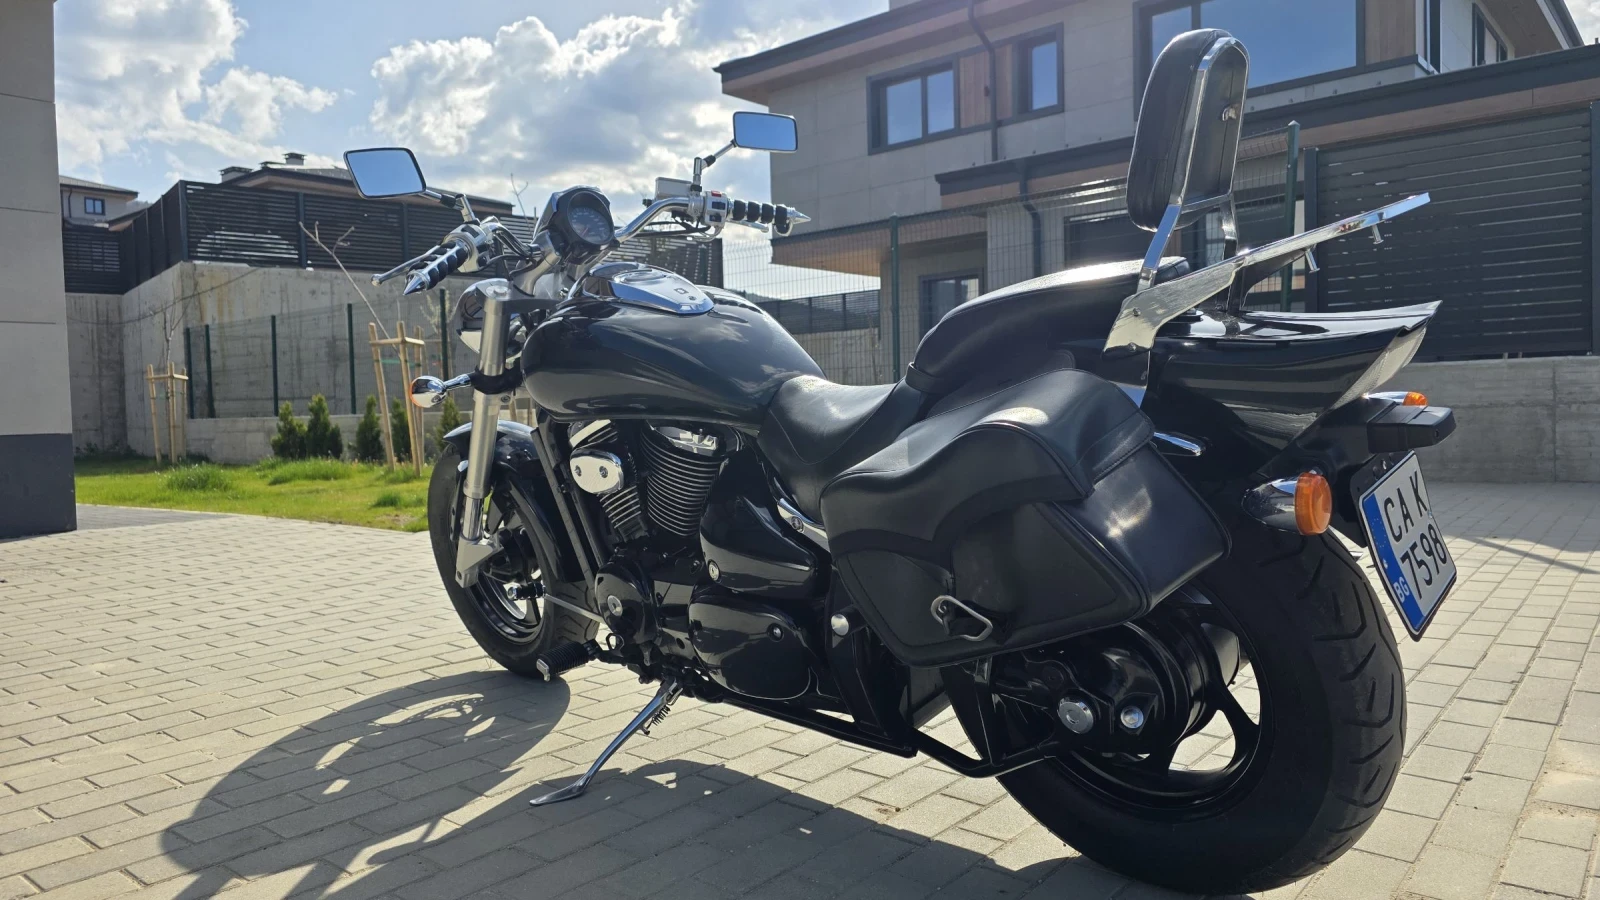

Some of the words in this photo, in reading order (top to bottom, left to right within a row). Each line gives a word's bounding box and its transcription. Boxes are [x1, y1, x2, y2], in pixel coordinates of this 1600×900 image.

[1384, 487, 1414, 543] CA
[1409, 470, 1428, 518] K
[1393, 576, 1410, 604] BG
[1400, 523, 1448, 601] 7598
